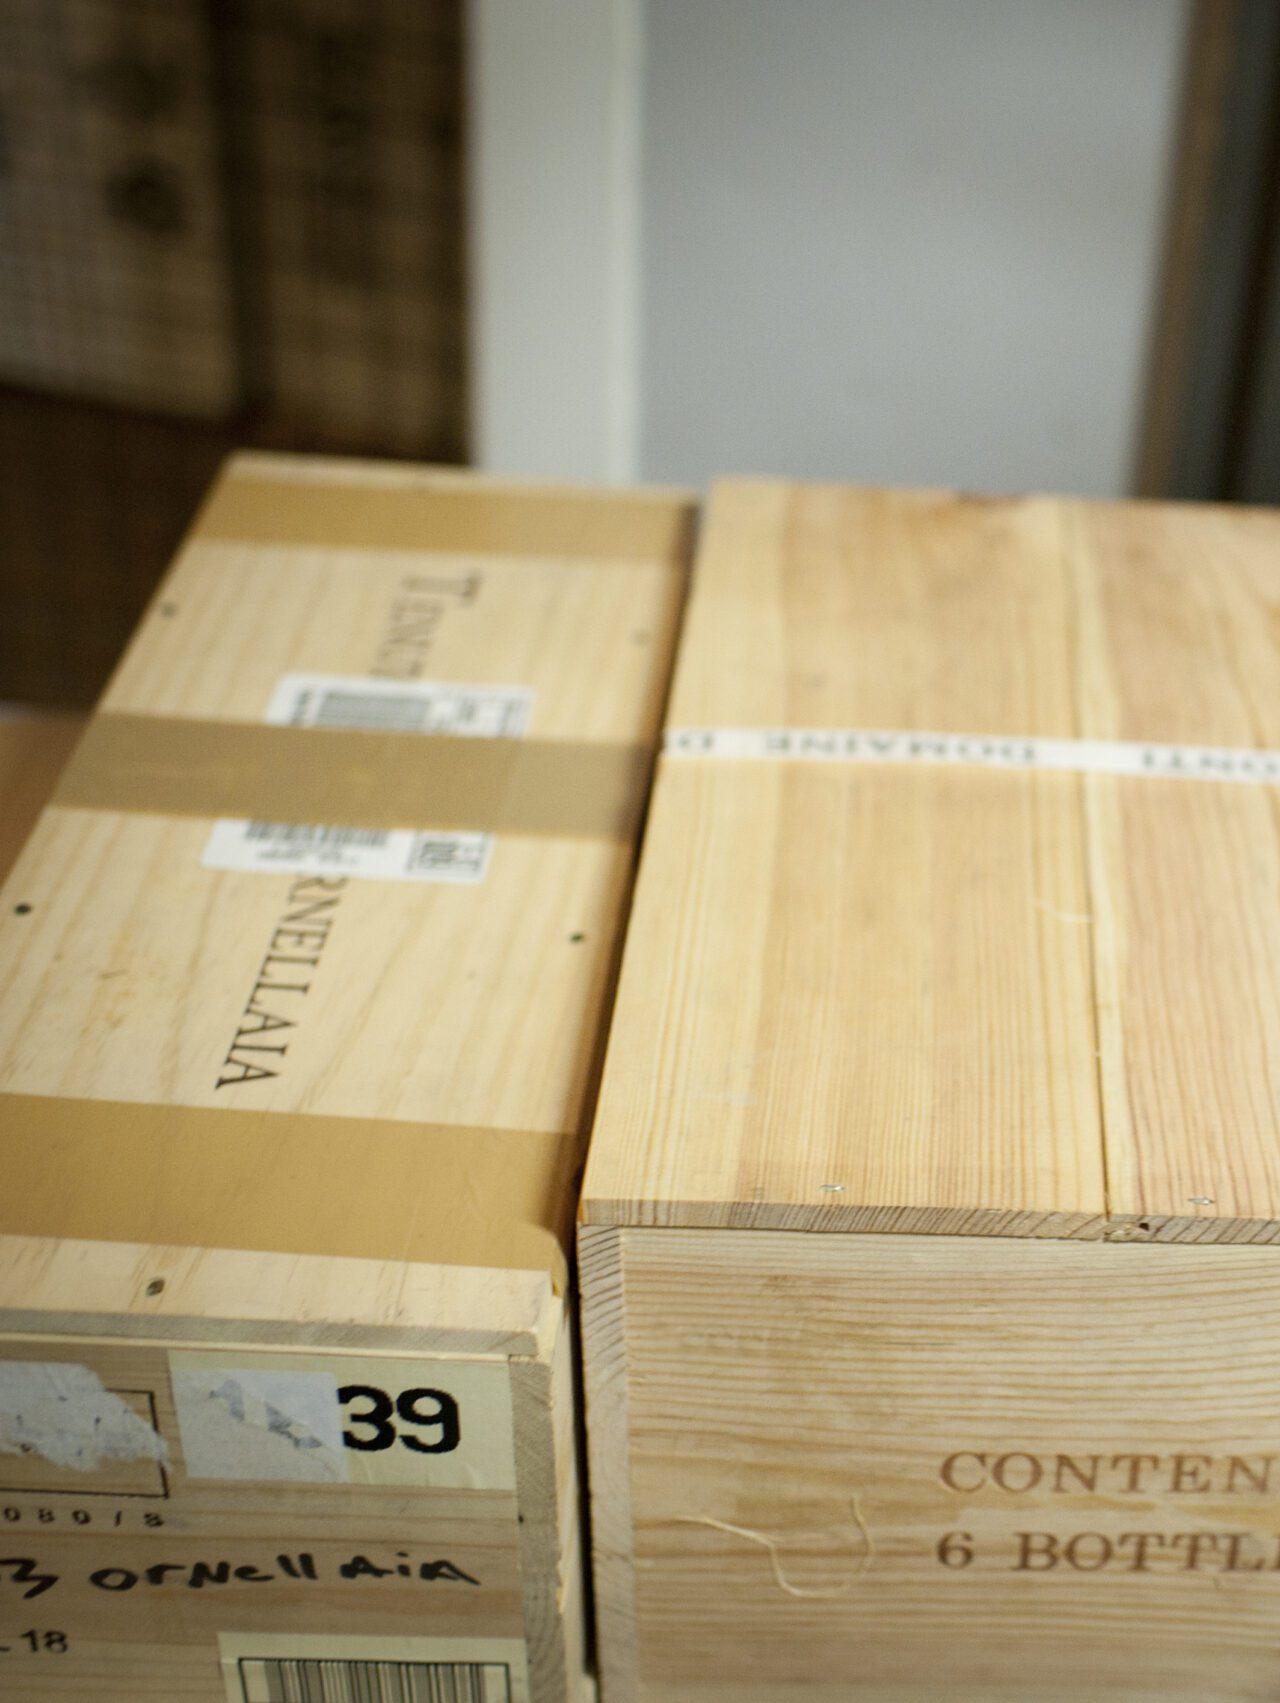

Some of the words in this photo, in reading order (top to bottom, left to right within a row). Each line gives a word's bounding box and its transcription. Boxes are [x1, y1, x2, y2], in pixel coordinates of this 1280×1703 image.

[762, 730, 1038, 763] DOMAINE
[336, 1385, 461, 1454] 39
[936, 1531, 975, 1571] 6
[0, 1628, 69, 1654] 18
